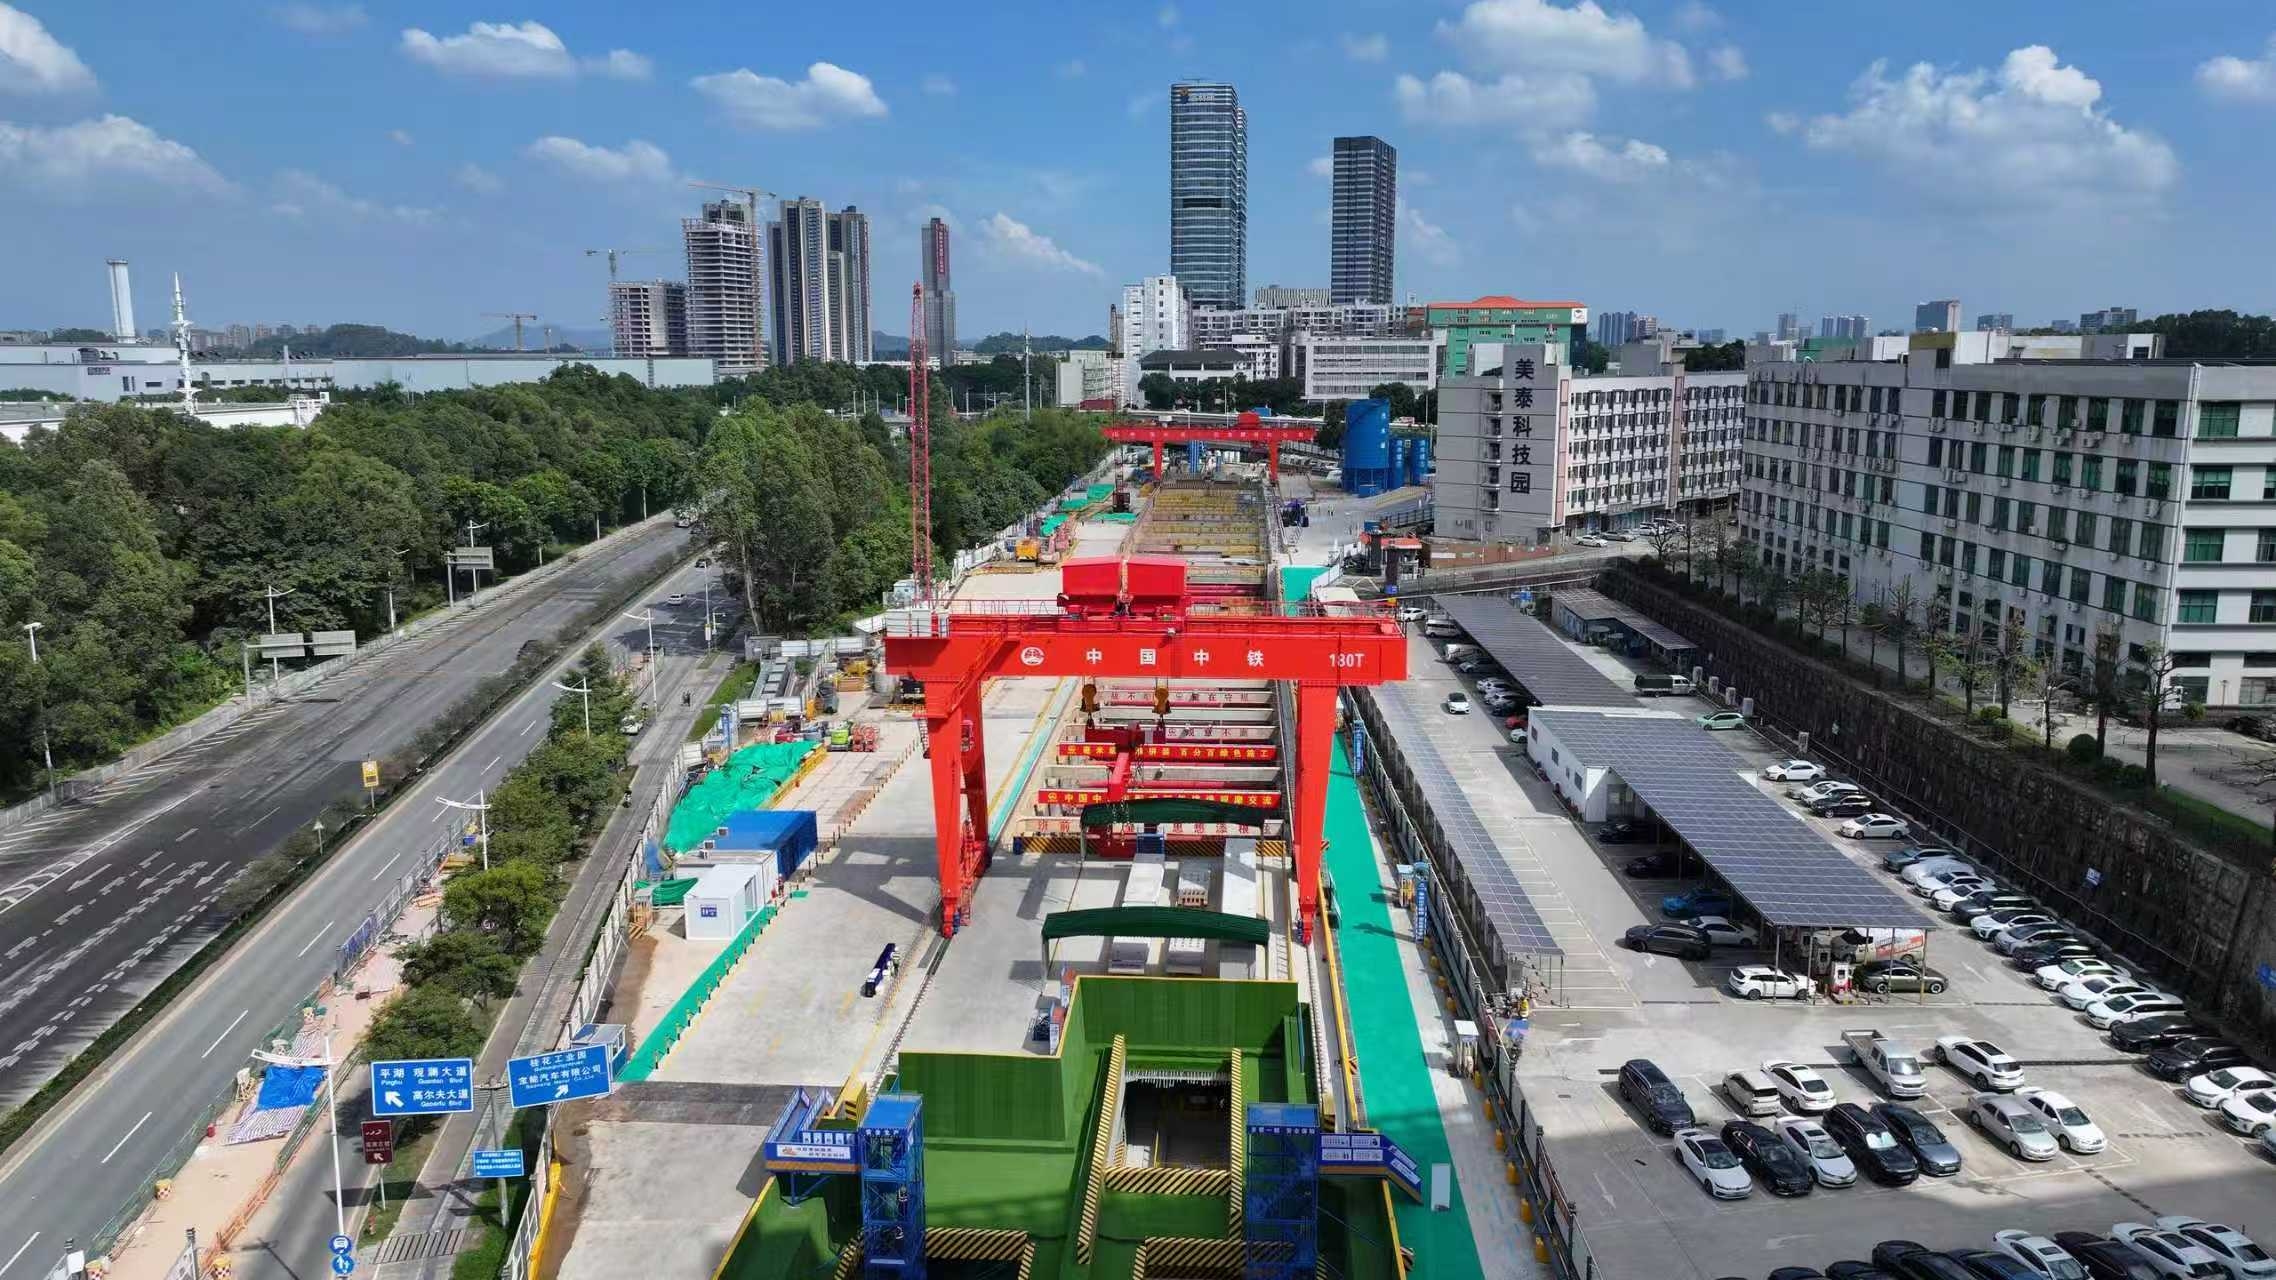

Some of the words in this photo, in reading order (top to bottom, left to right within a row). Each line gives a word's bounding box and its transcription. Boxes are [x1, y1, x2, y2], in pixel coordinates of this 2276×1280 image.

[1511, 358, 1534, 494] 美泰科技园
[1086, 648, 1264, 667] 中国中铁
[530, 1050, 587, 1067] 桂花工业园
[380, 1068, 405, 1079] 平湖
[413, 1065, 467, 1077] 观澜大道
[518, 1064, 601, 1086] 宝能汽车有限公司
[413, 1088, 468, 1100] 高尔夫大道
